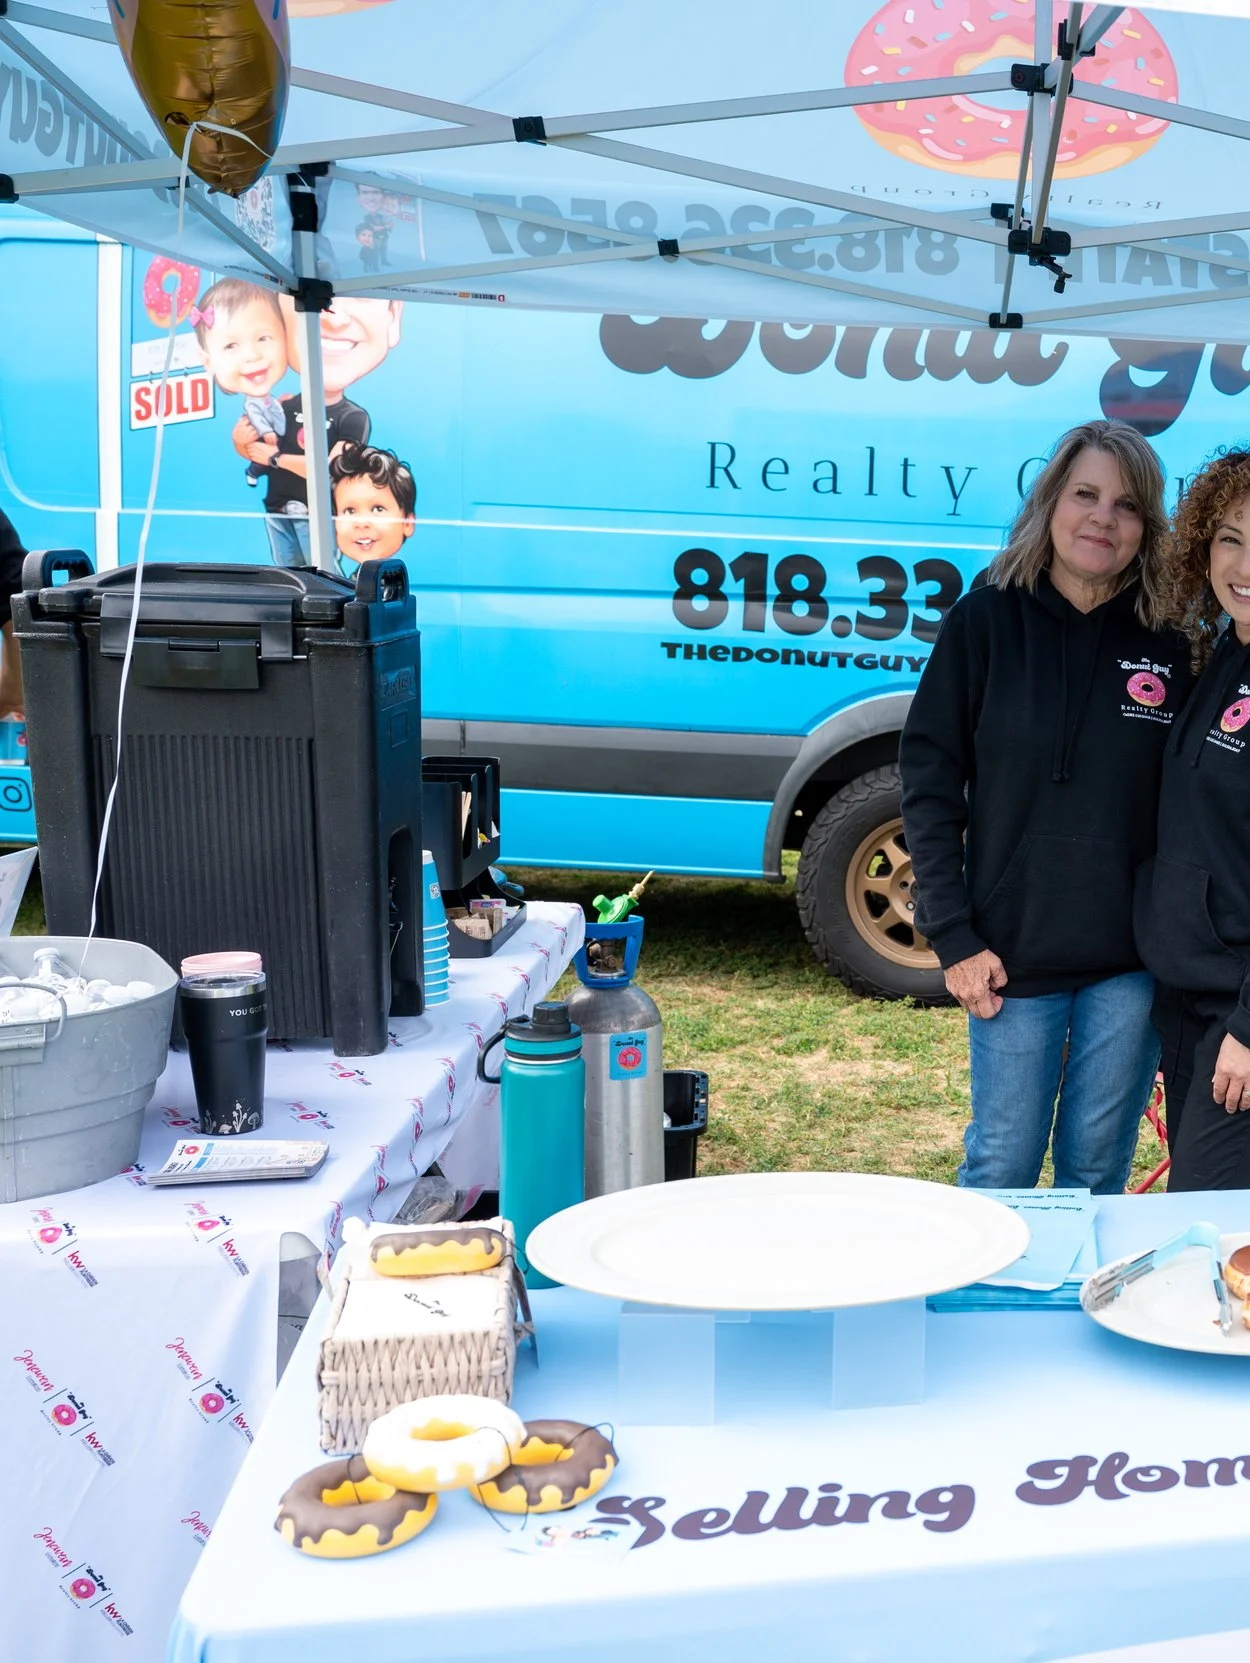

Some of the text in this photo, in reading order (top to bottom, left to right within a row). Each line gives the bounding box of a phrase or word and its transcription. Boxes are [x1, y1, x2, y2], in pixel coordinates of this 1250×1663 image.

[134, 377, 211, 421] SOLD
[705, 441, 977, 516] Realty
[672, 548, 989, 644] 818.33
[1121, 704, 1148, 715] Realty
[1150, 708, 1174, 719] Group
[1223, 733, 1246, 749] Group
[229, 1008, 248, 1017] YOU
[596, 1482, 975, 1549] Selling
